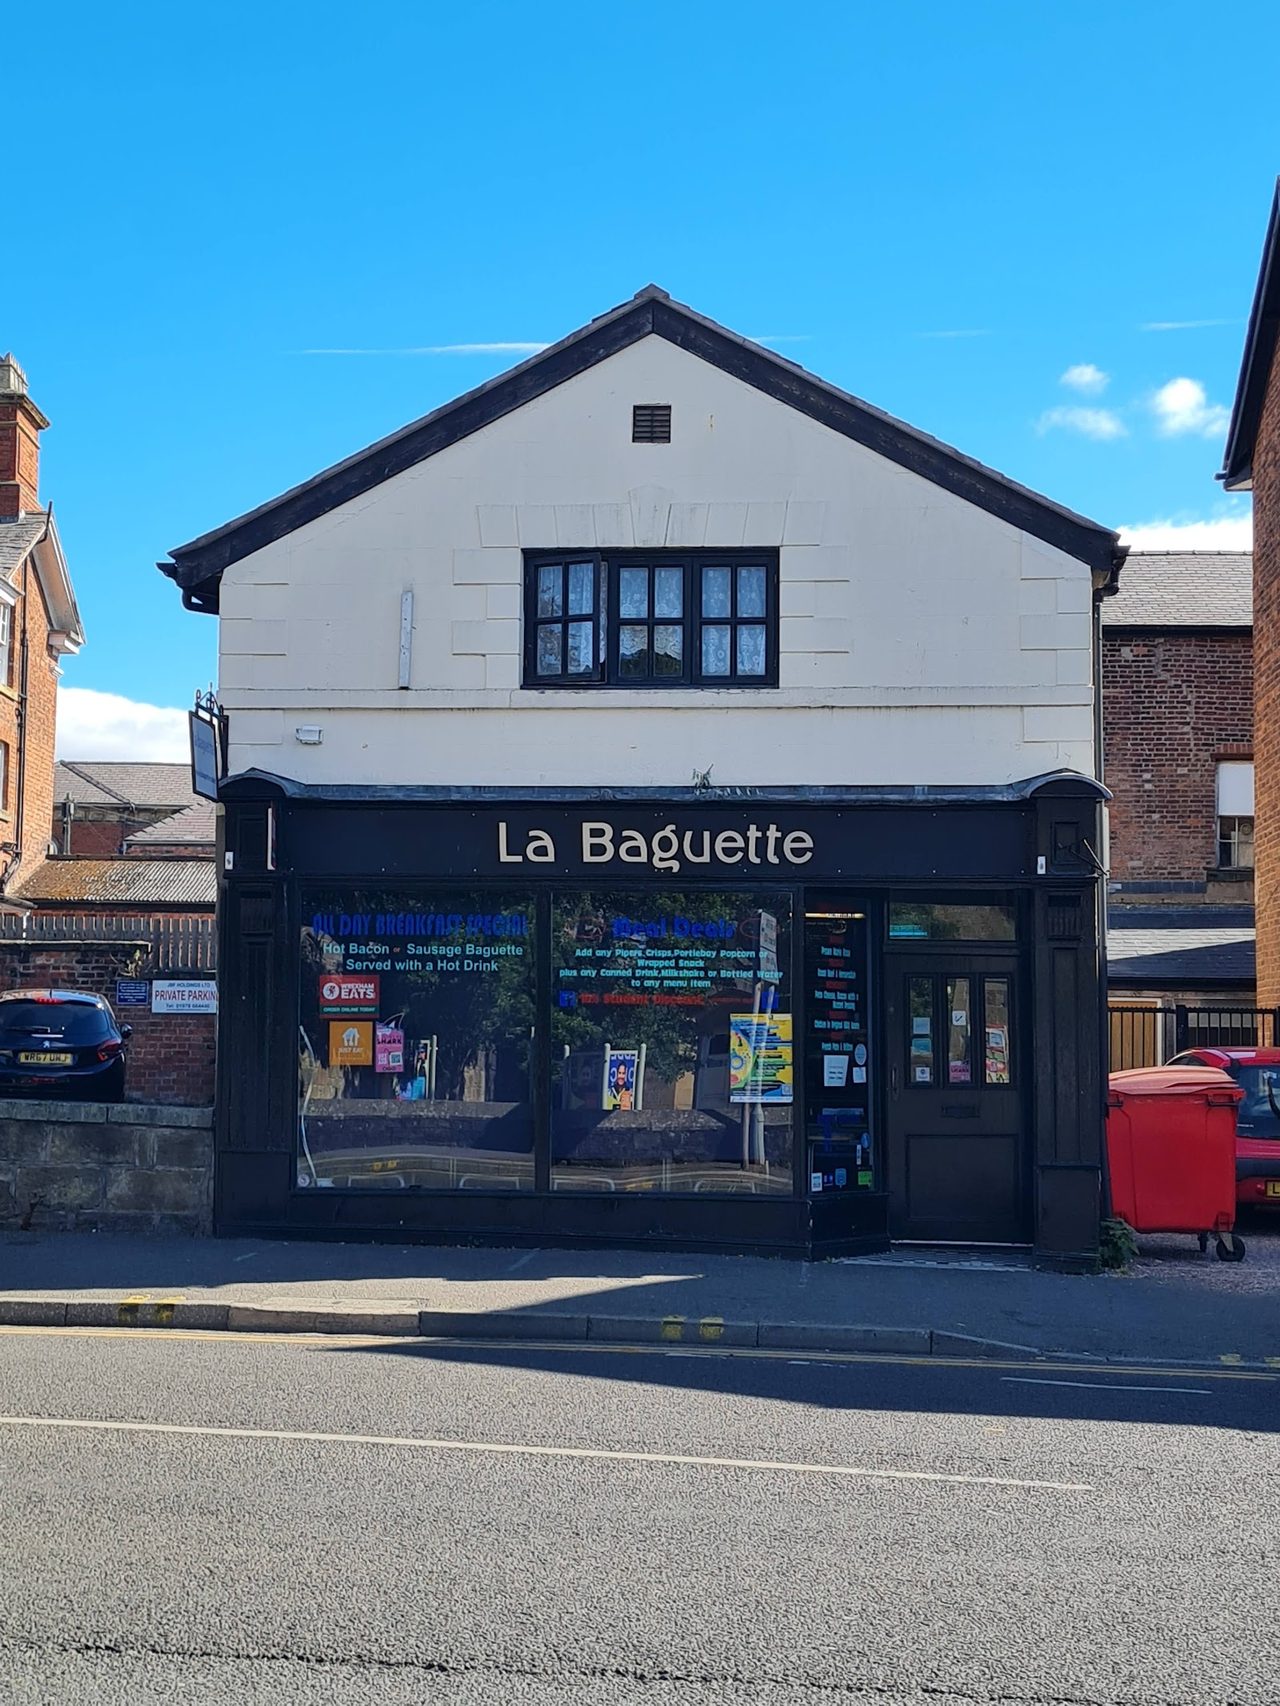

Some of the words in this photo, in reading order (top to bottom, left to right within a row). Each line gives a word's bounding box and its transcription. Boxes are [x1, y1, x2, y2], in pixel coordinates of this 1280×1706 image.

[498, 822, 555, 863] La
[582, 822, 814, 873] Baguette
[323, 943, 345, 954] Hot
[350, 943, 389, 955] Bacon
[407, 943, 461, 957] Sausage
[466, 944, 523, 957] Baguette
[575, 949, 592, 958] Add
[595, 950, 611, 959] any
[720, 950, 755, 959] Popcorn
[346, 959, 391, 971] Served
[395, 959, 422, 971] with
[425, 962, 434, 971] a
[438, 959, 460, 971] Hot
[464, 959, 498, 971] Drink
[637, 959, 675, 969] Wrapped
[678, 959, 705, 968] Snack
[560, 969, 577, 979] plus
[580, 970, 597, 979] any
[600, 969, 632, 978] Canned
[720, 970, 753, 978] Bottled
[757, 970, 783, 979] Water
[631, 979, 641, 987] to
[644, 980, 660, 989] any
[155, 990, 185, 1001] PRIVATE
[188, 990, 217, 1001] PARKIN
[340, 988, 375, 999] EATS
